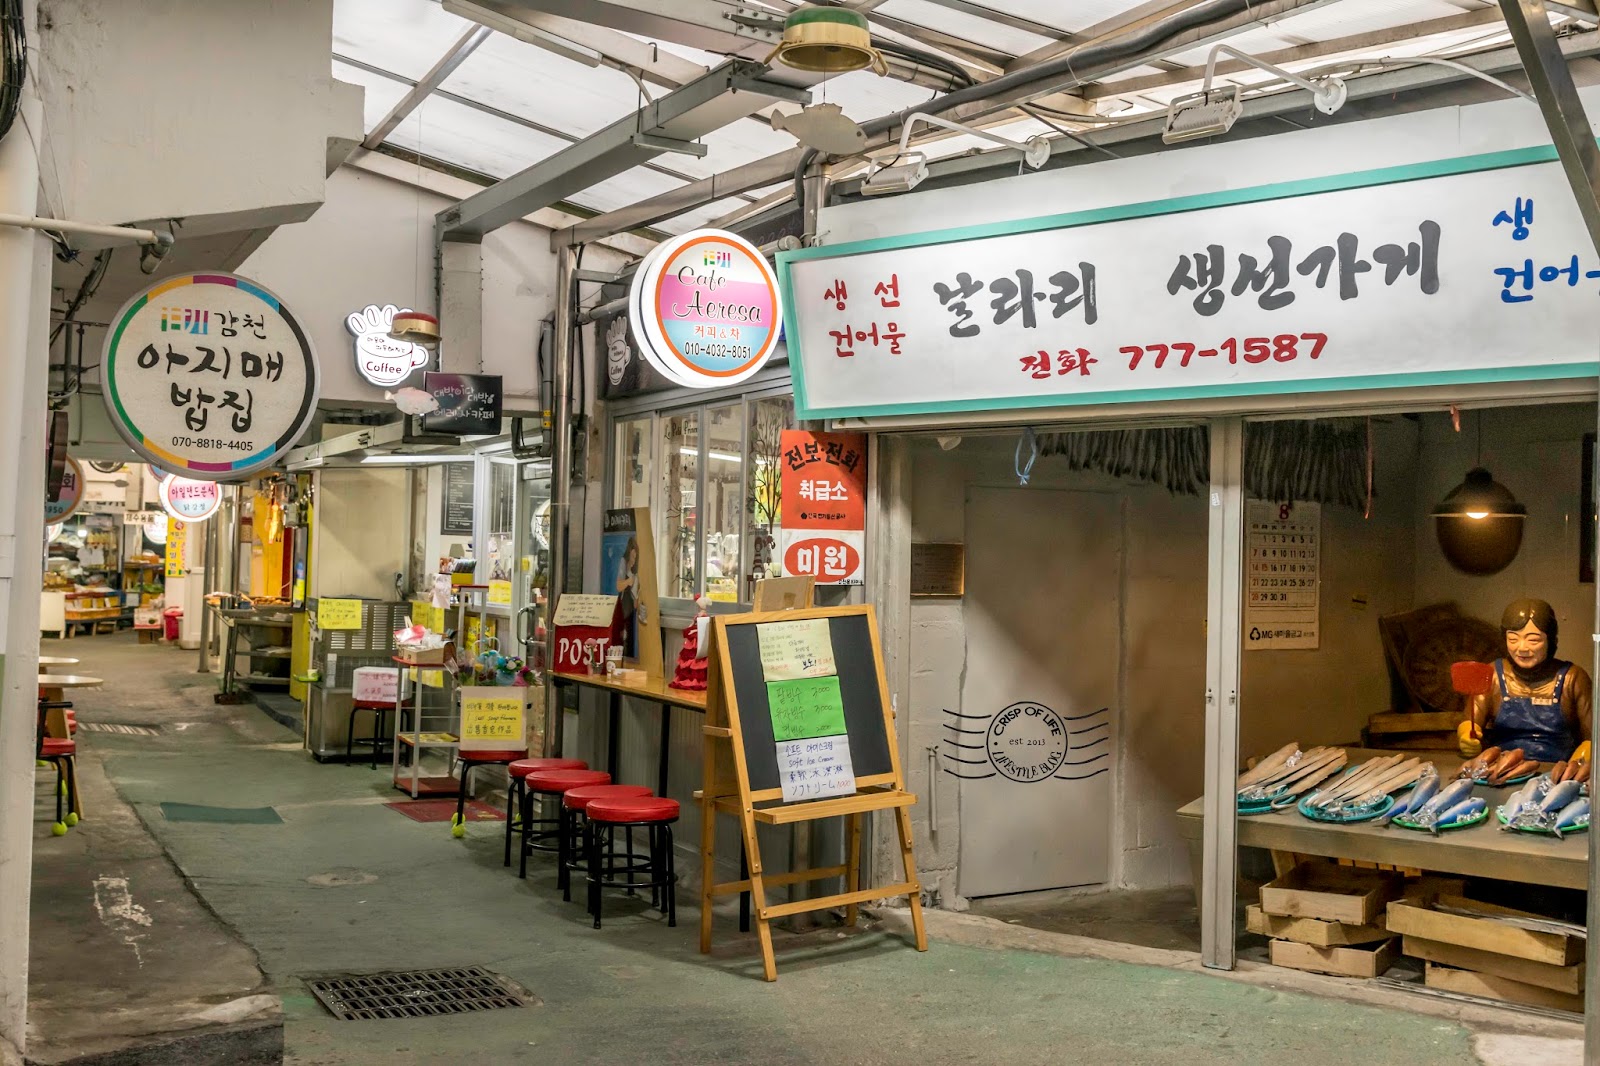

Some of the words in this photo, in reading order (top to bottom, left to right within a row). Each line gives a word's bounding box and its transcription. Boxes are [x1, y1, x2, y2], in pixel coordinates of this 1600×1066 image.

[1492, 197, 1533, 241] 생
[678, 265, 726, 291] Cafe
[933, 261, 1099, 338] 날라리
[1167, 219, 1441, 317] 생선가게
[1494, 254, 1600, 303] 건어
[672, 291, 762, 322] Aeresa
[213, 310, 267, 340] 감천
[828, 321, 906, 358] 건어물
[137, 343, 284, 383] 아지매
[684, 341, 752, 359] 010-4032-8051
[1018, 348, 1098, 380] 전화
[1119, 332, 1329, 371] 777-1587
[366, 361, 402, 374] Coffee
[170, 382, 253, 432] 밥집
[171, 436, 254, 452] 070-8818-4405
[171, 485, 215, 498] 아일랜드분식
[799, 479, 848, 501] 취급소
[1279, 504, 1289, 520] 8
[797, 545, 847, 576] 미원
[1261, 630, 1273, 639] MG
